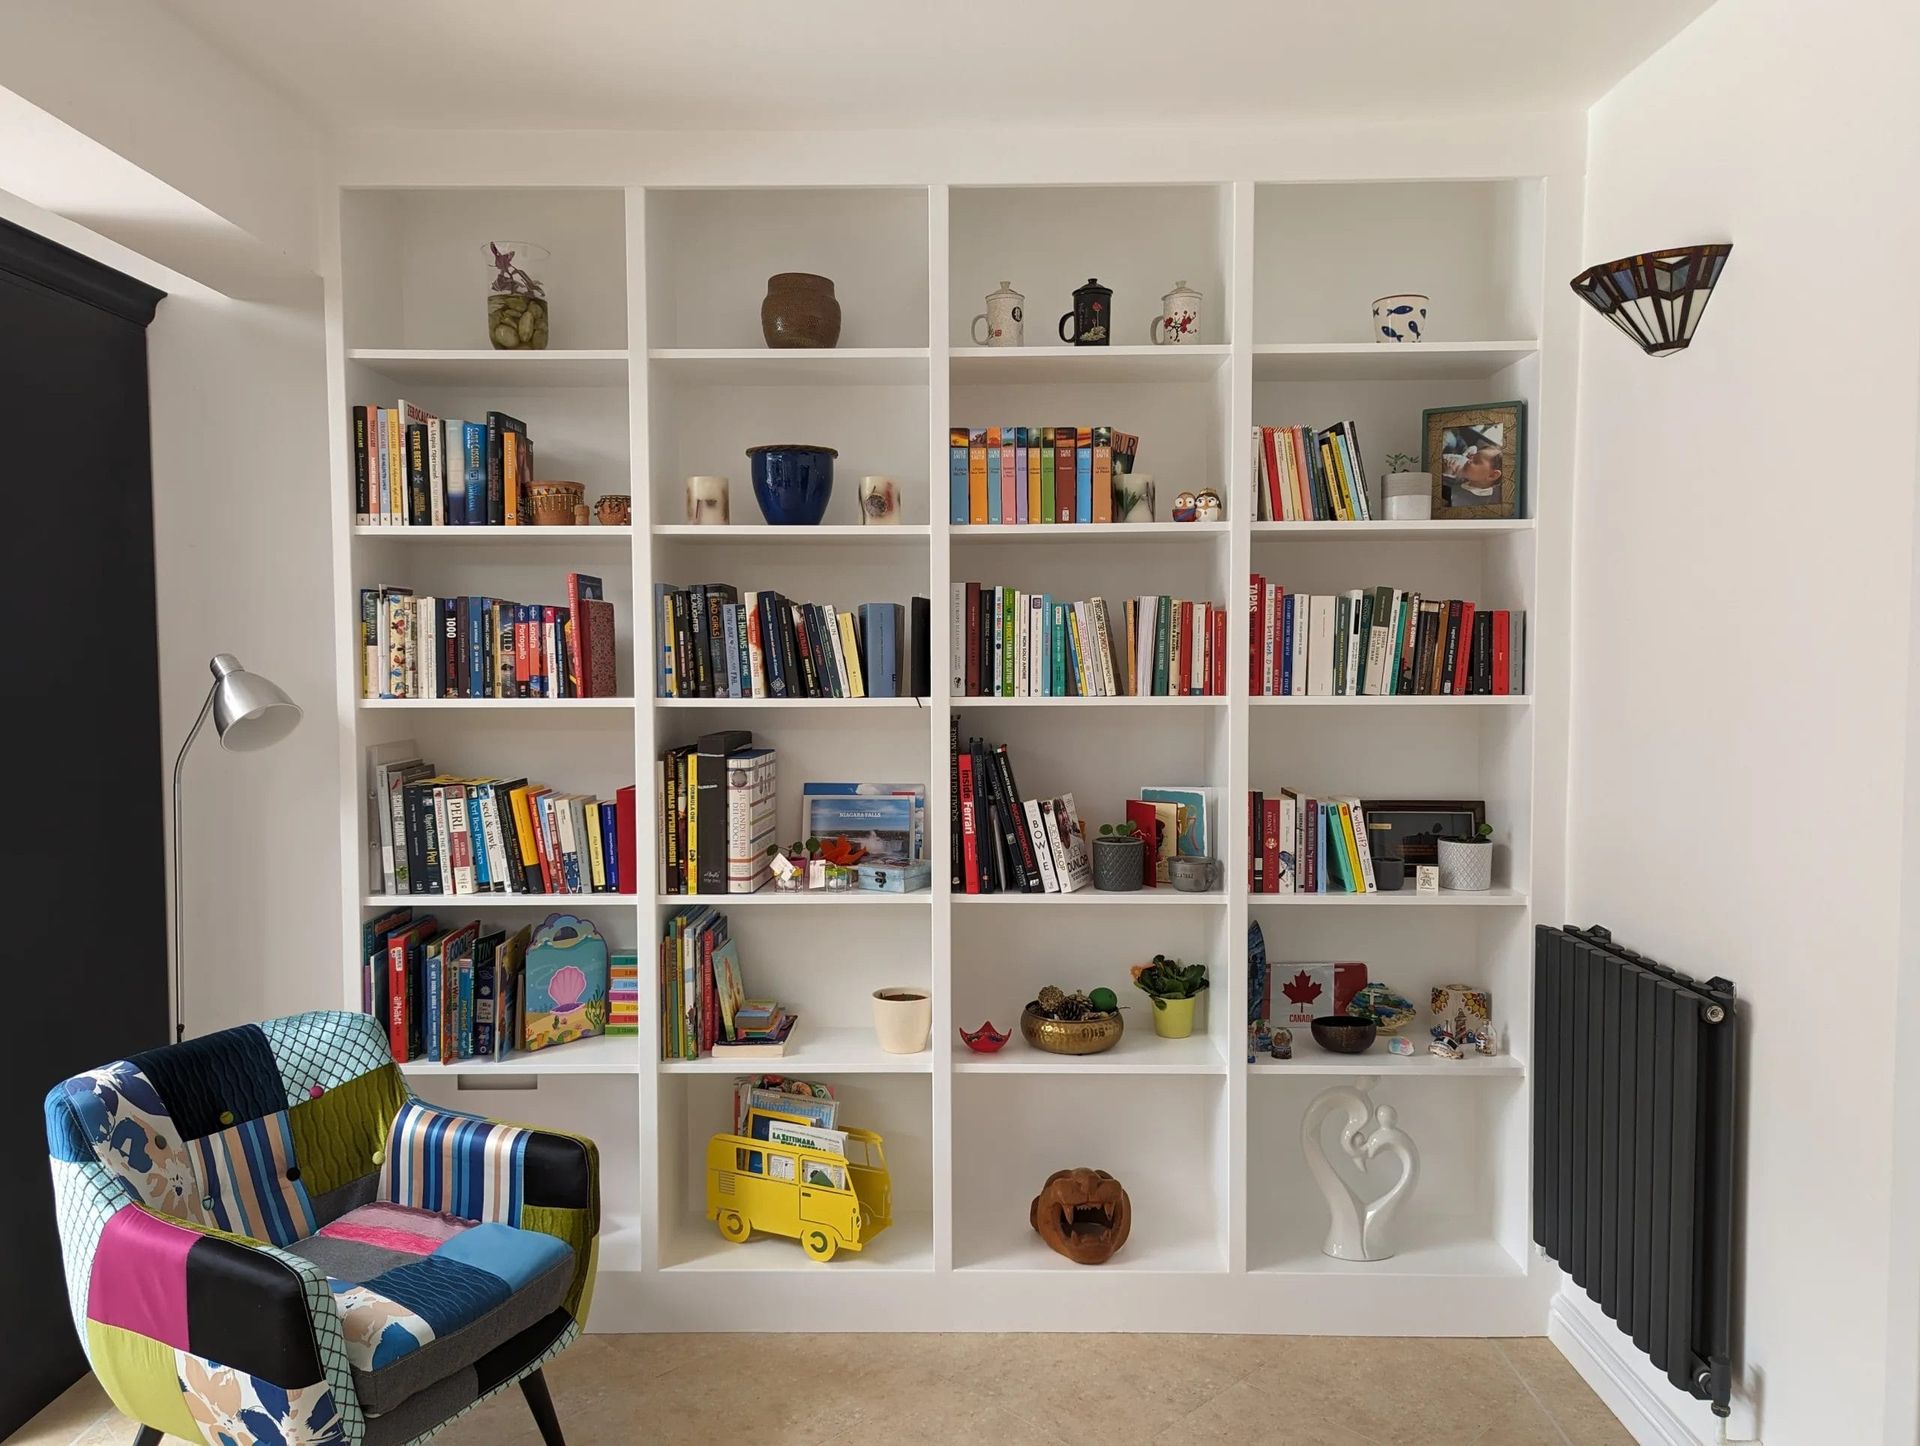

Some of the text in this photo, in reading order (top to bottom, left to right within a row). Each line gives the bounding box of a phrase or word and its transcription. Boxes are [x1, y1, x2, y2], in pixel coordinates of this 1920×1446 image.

[414, 450, 422, 471] BERRY
[431, 450, 440, 480] Experiment
[471, 444, 480, 467] CUSSLER
[690, 593, 699, 632] SLAUGHTER
[1250, 584, 1258, 612] TAPAS
[446, 617, 456, 638] 1000
[827, 609, 835, 627] LEAN
[504, 622, 512, 651] WILD
[518, 624, 527, 659] Portogallo
[738, 622, 747, 649] HUMANS
[451, 801, 463, 830] PERL
[470, 801, 479, 815] Perl
[962, 770, 974, 834] inside Ferrari
[1011, 803, 1021, 824] DUCATI
[392, 795, 405, 846] SCIENCE COOKING
[482, 801, 496, 850] sed & awk
[1353, 815, 1368, 848] what if?
[424, 814, 438, 865] Object Oriented Perl
[474, 834, 484, 864] Practices
[1015, 825, 1032, 869] MOTORCYCLES
[1033, 820, 1050, 871] BOWIE
[1049, 824, 1066, 871] JOEY DUNLOP
[393, 996, 402, 1025] alphabet
[772, 1132, 780, 1140] LA
[780, 1134, 816, 1146] SETTIMANA
